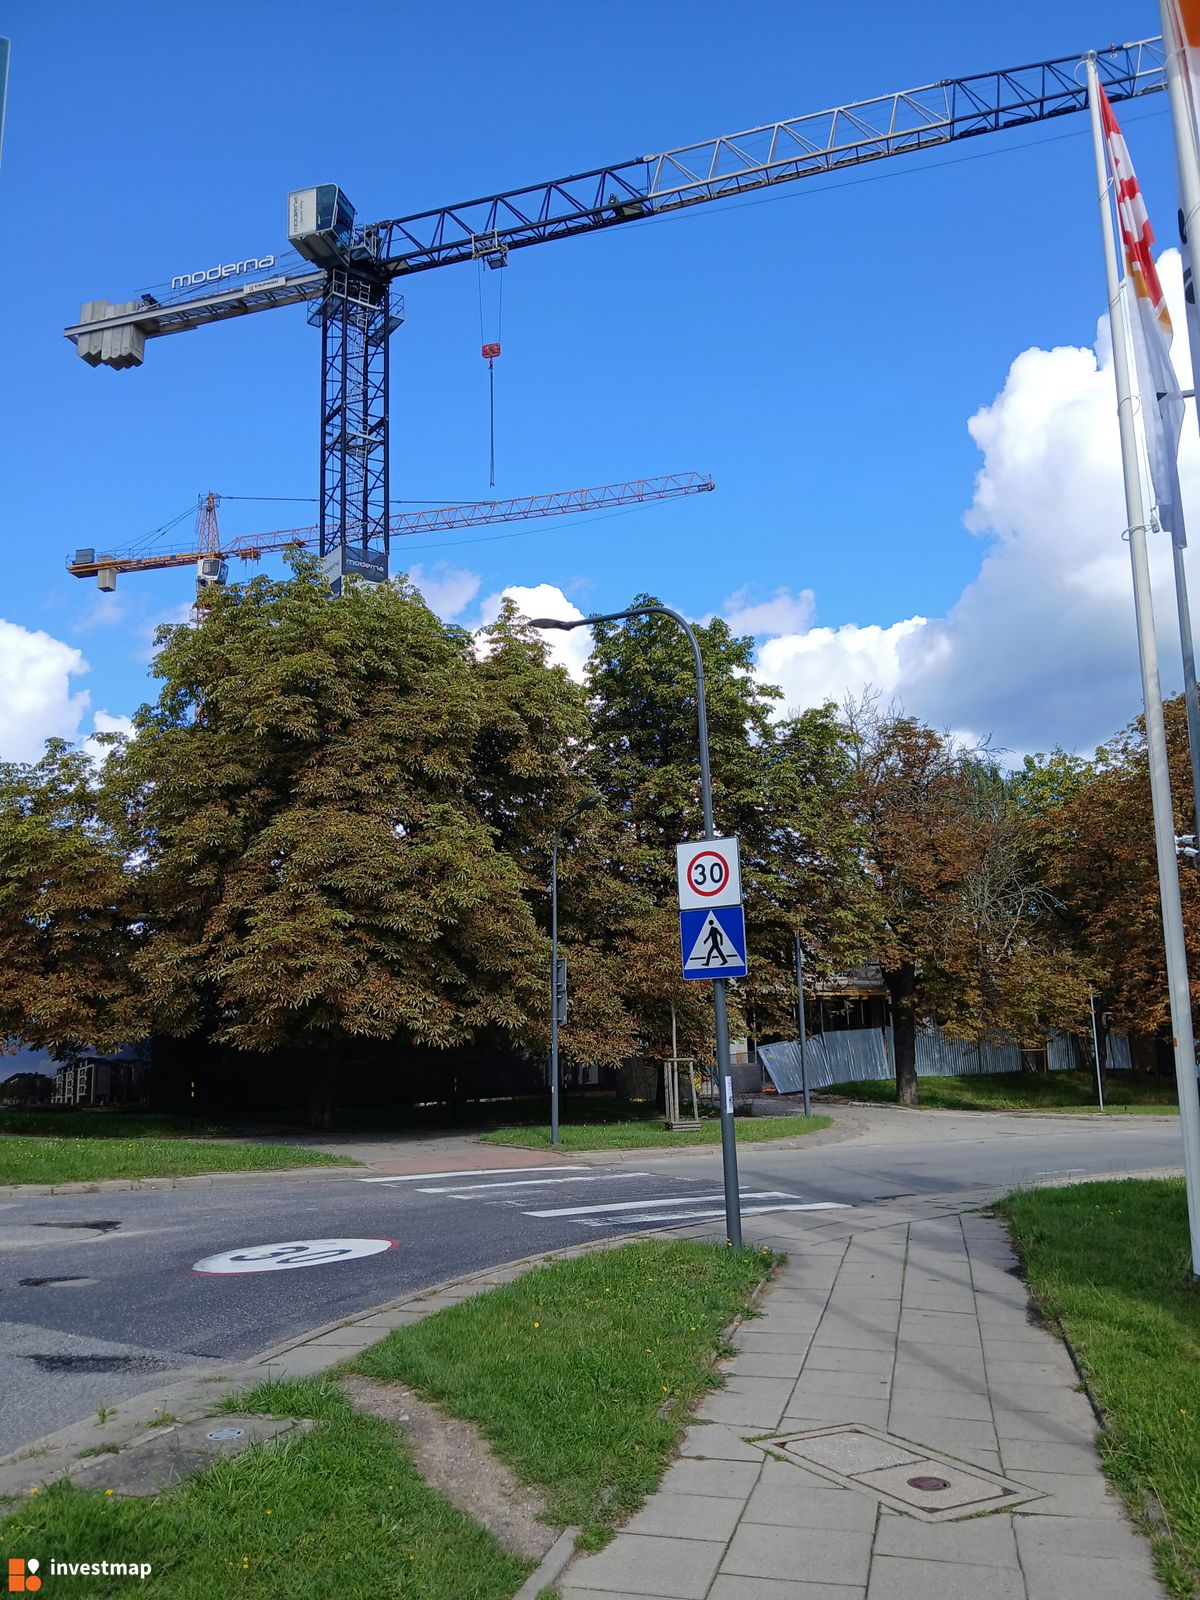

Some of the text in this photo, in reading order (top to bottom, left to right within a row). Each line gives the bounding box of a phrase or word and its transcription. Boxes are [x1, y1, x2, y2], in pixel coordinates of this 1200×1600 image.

[171, 255, 275, 289] moderna
[346, 559, 384, 571] moderna
[693, 862, 724, 886] 30
